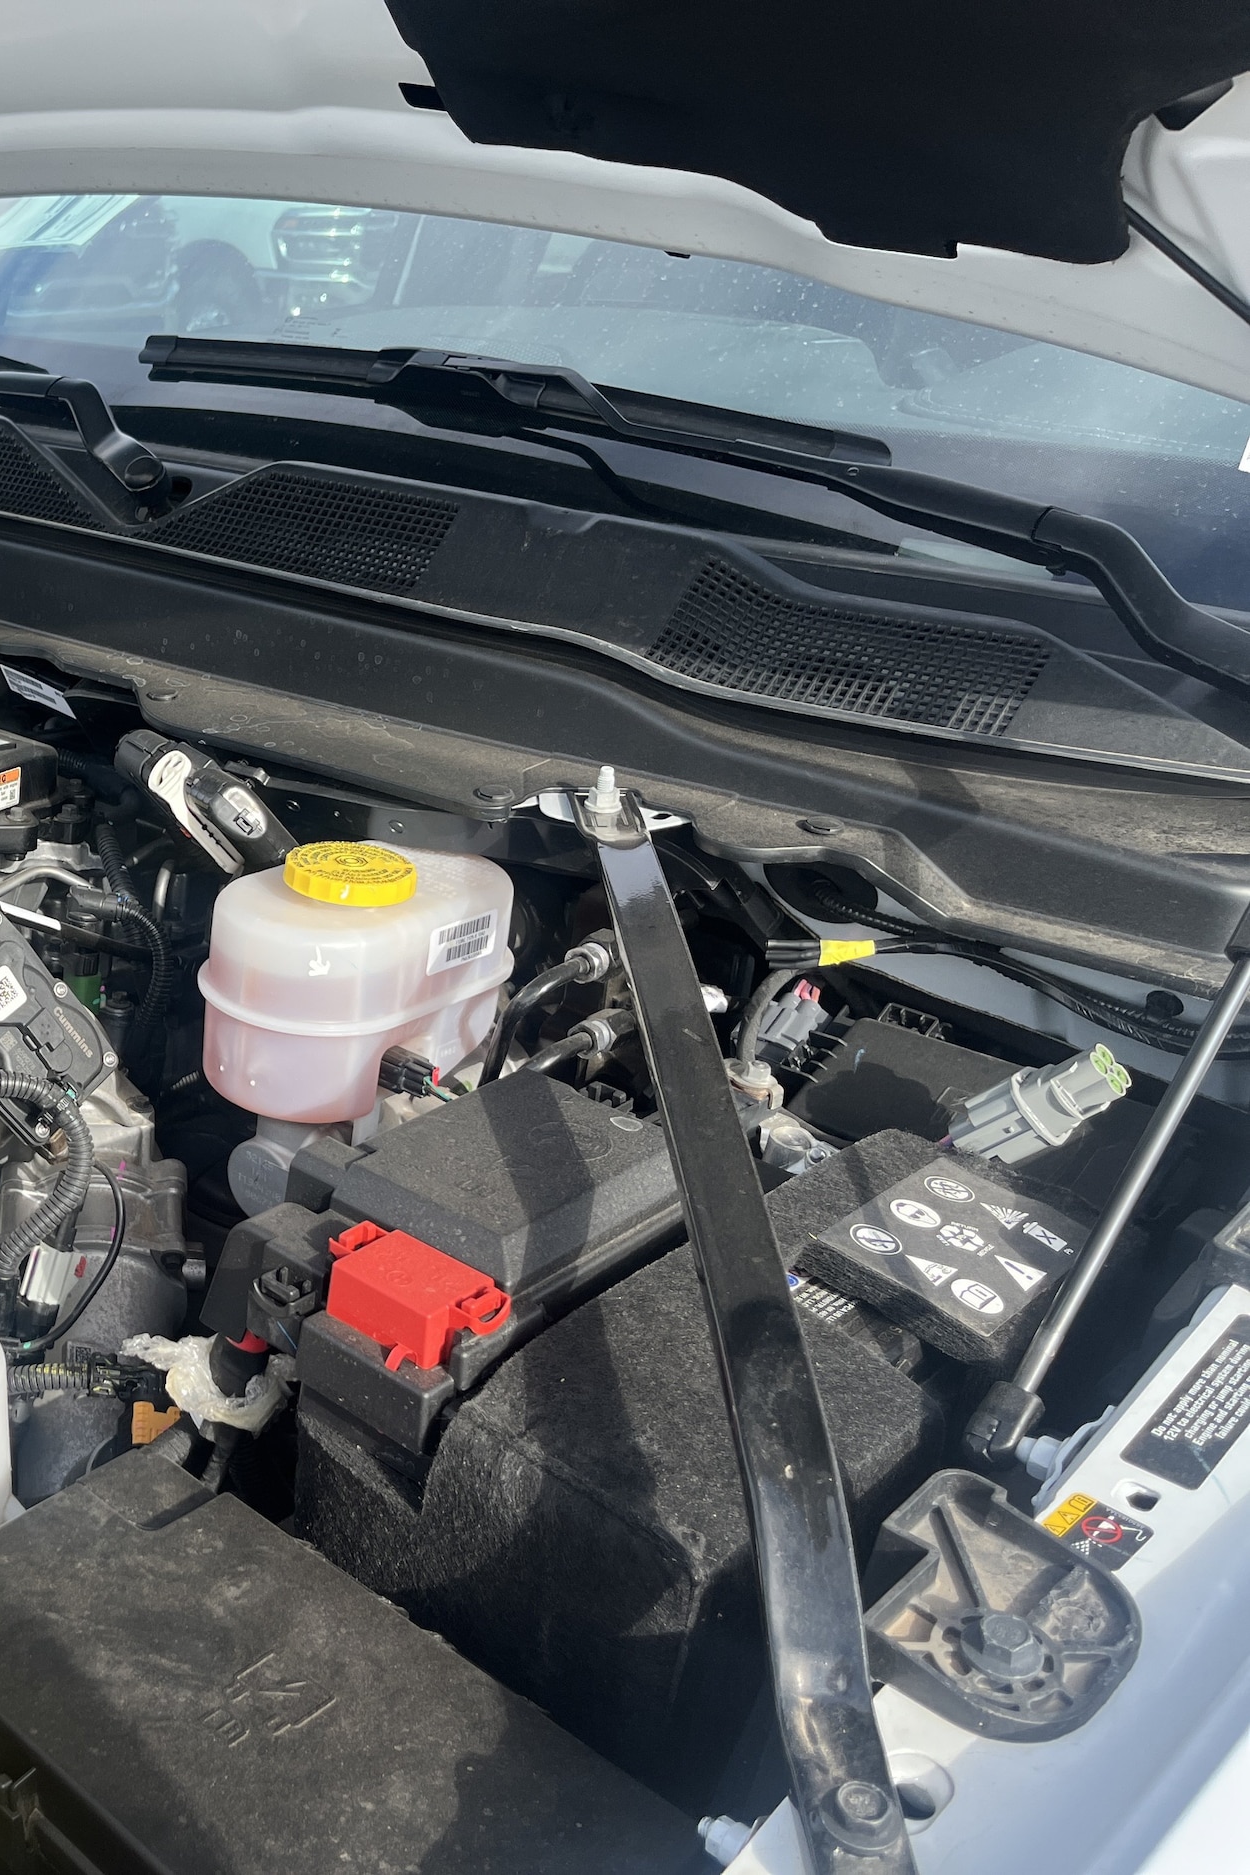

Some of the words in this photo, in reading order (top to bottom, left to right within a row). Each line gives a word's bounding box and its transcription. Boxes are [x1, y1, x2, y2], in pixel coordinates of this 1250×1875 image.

[53, 1006, 93, 1058] Cummins
[1151, 1426, 1166, 1437] Do
[1163, 1413, 1177, 1426] not
[1173, 1394, 1194, 1414] apply
[1188, 1378, 1206, 1395] more
[1201, 1363, 1219, 1379] than
[1215, 1339, 1239, 1364] nominal
[1164, 1425, 1182, 1441] 12V
[1177, 1418, 1190, 1427] to
[1185, 1386, 1215, 1418] electrical
[1211, 1364, 1234, 1387] system
[1185, 1410, 1214, 1439] charging
[1208, 1401, 1219, 1410] or
[1214, 1385, 1233, 1402] jump
[1192, 1423, 1218, 1446] Engine
[1214, 1409, 1228, 1423] and
[1214, 1417, 1239, 1439] failure
